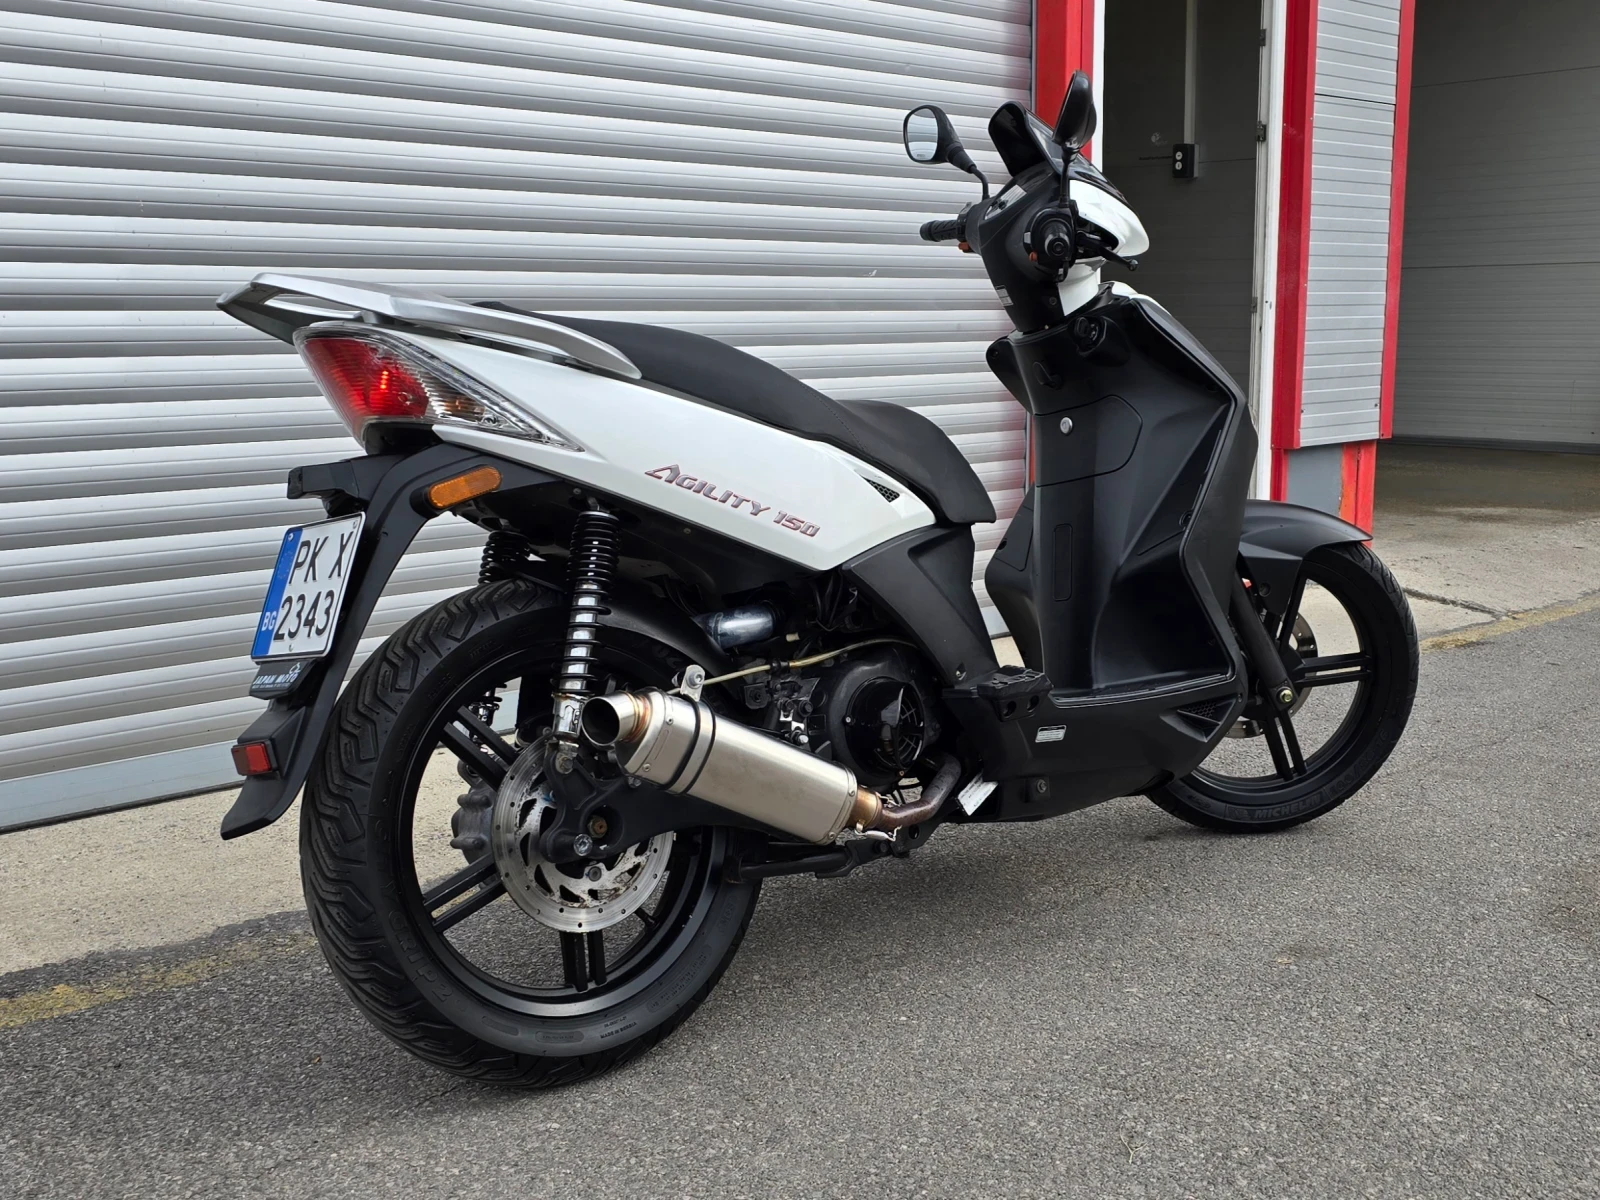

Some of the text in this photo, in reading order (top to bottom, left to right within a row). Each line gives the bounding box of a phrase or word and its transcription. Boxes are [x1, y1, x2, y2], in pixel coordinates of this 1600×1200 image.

[645, 464, 820, 537] AGILITY 150
[288, 531, 354, 585] PK X
[261, 611, 277, 632] BG
[273, 589, 335, 641] 2343
[252, 672, 299, 685] JAPAN MOTO
[1254, 792, 1321, 819] MICHELIN
[387, 910, 438, 982] GRIP
[432, 983, 454, 1003] 2
